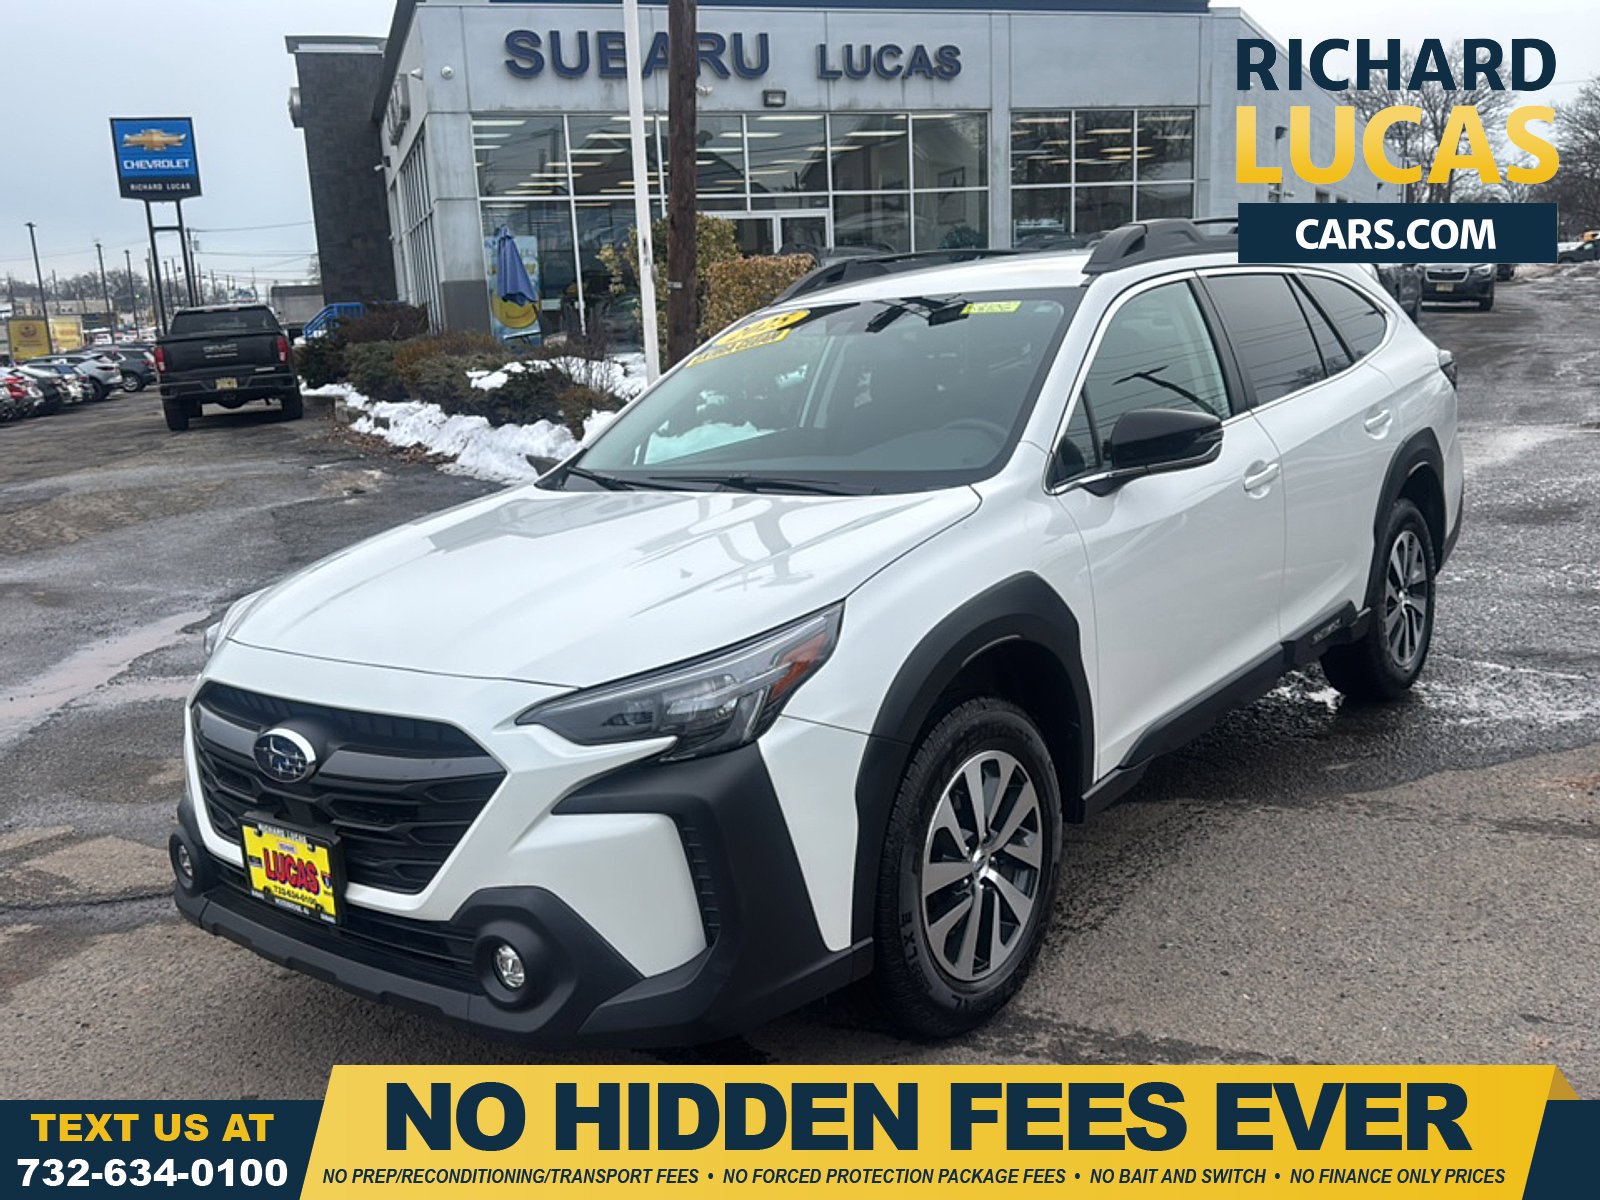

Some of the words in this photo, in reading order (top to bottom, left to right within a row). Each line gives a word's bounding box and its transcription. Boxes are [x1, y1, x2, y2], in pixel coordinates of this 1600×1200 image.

[504, 29, 770, 80] SUBARU
[817, 43, 962, 80] LUCAS
[123, 158, 191, 170] CHEVROLET
[129, 183, 163, 191] RICHARD
[166, 182, 191, 190] LUCAS
[263, 848, 319, 895] LUCAS
